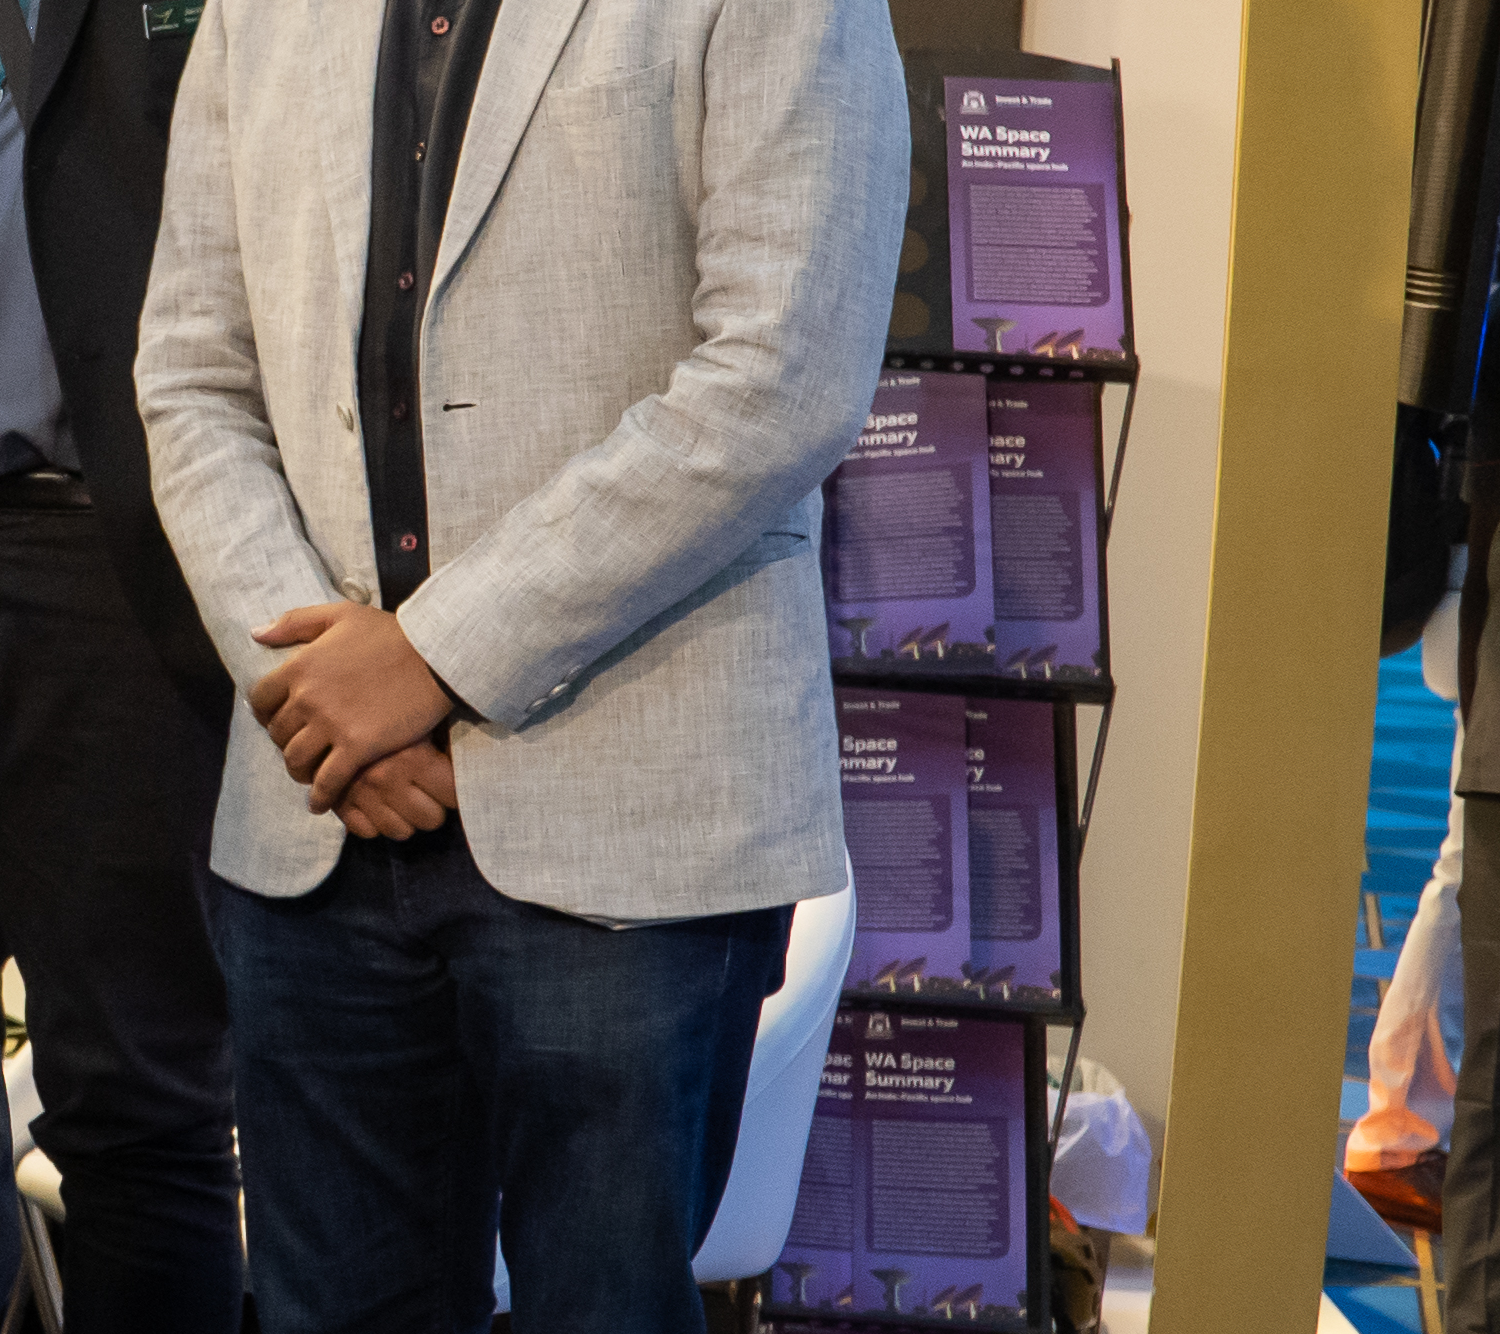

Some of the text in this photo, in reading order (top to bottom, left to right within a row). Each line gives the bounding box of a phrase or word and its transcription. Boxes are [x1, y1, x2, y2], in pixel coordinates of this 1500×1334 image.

[960, 125, 1050, 144] WA Space
[961, 141, 1050, 162] Summary
[858, 431, 917, 446] mmary
[843, 735, 897, 754] Space
[840, 756, 897, 773] mmary
[865, 1051, 955, 1073] WA Space
[865, 1069, 954, 1093] Summary
